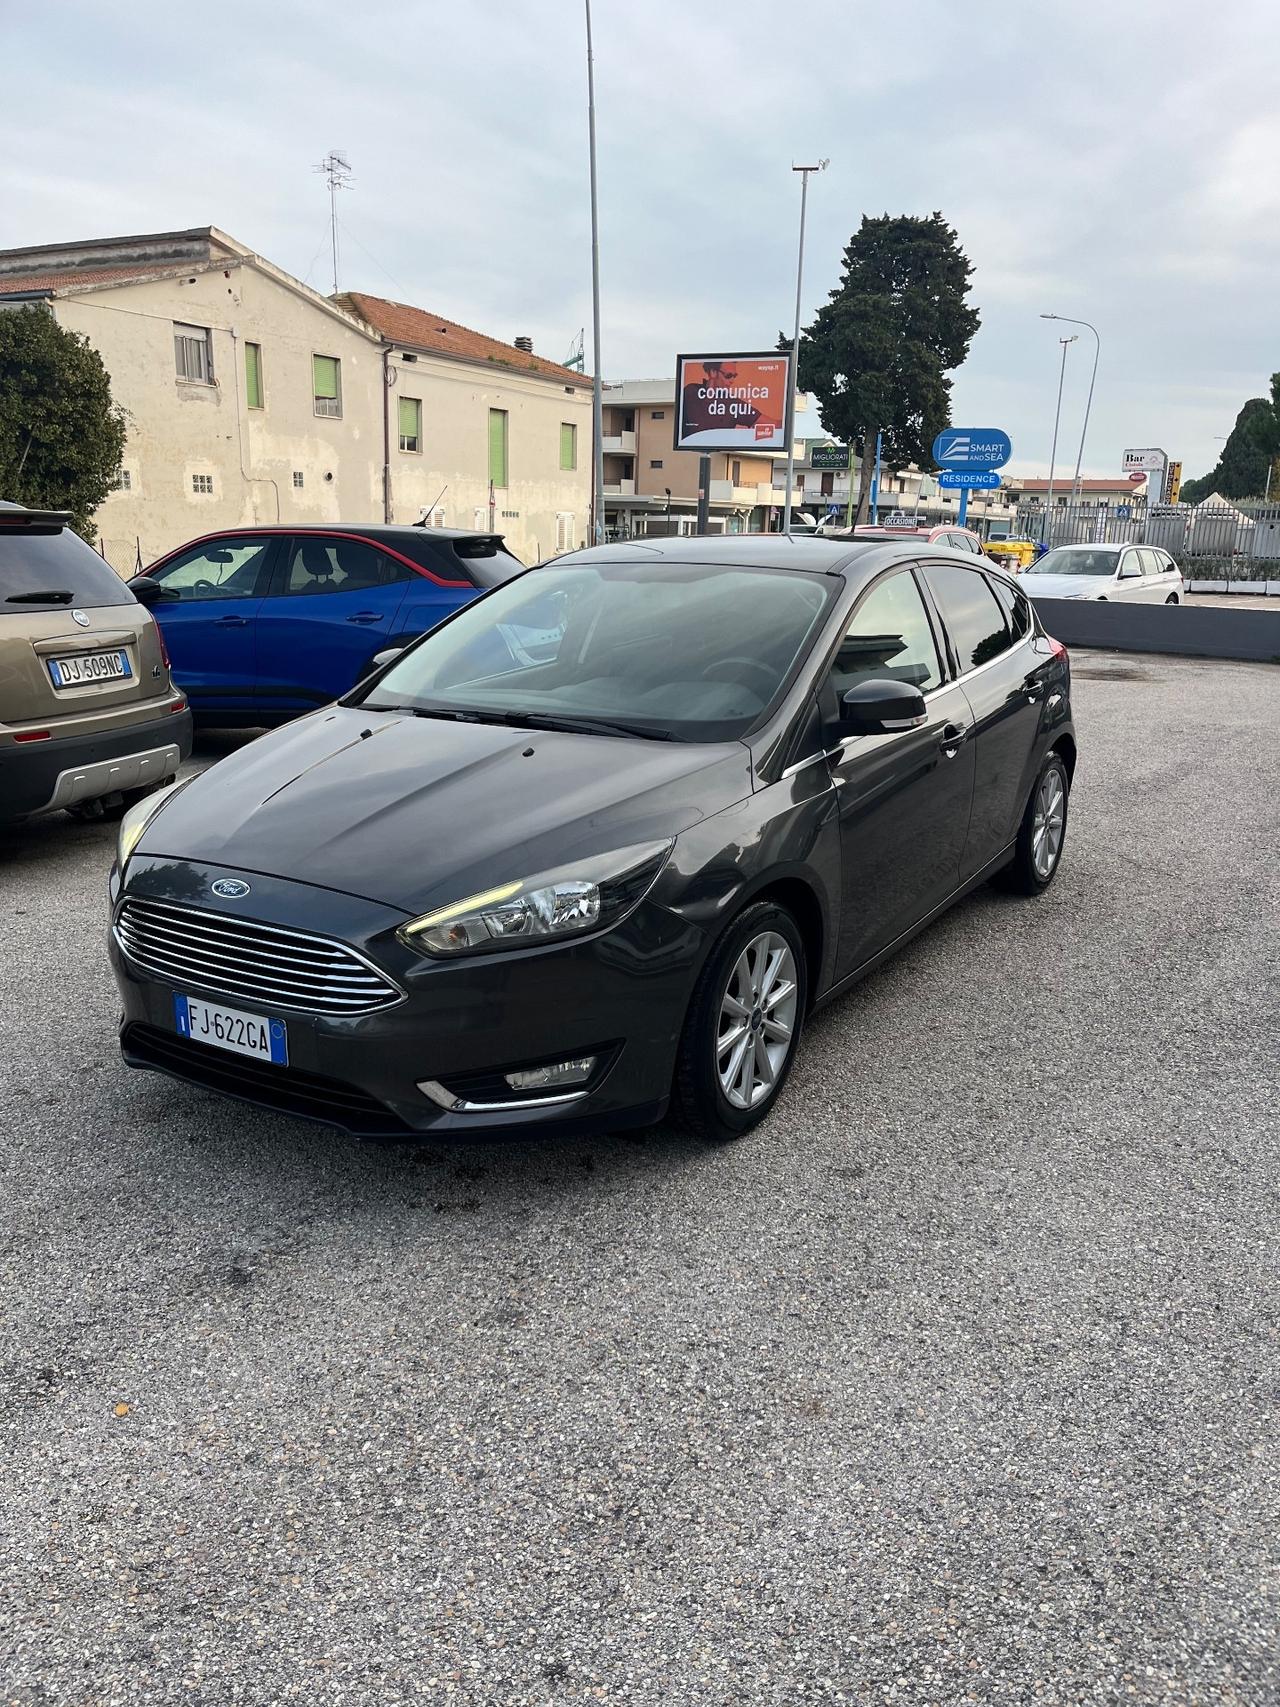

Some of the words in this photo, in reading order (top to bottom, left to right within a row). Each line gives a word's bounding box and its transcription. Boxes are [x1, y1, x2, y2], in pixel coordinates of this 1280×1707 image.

[697, 383, 769, 399] comunica
[708, 400, 725, 415] da
[729, 400, 756, 418] qui.
[970, 444, 1004, 452] SMART
[813, 453, 848, 461] MIGLIORATI
[985, 453, 1004, 461] SEA
[1126, 454, 1145, 462] Bar
[942, 474, 996, 483] RESIDENCE
[218, 881, 242, 894] Ford
